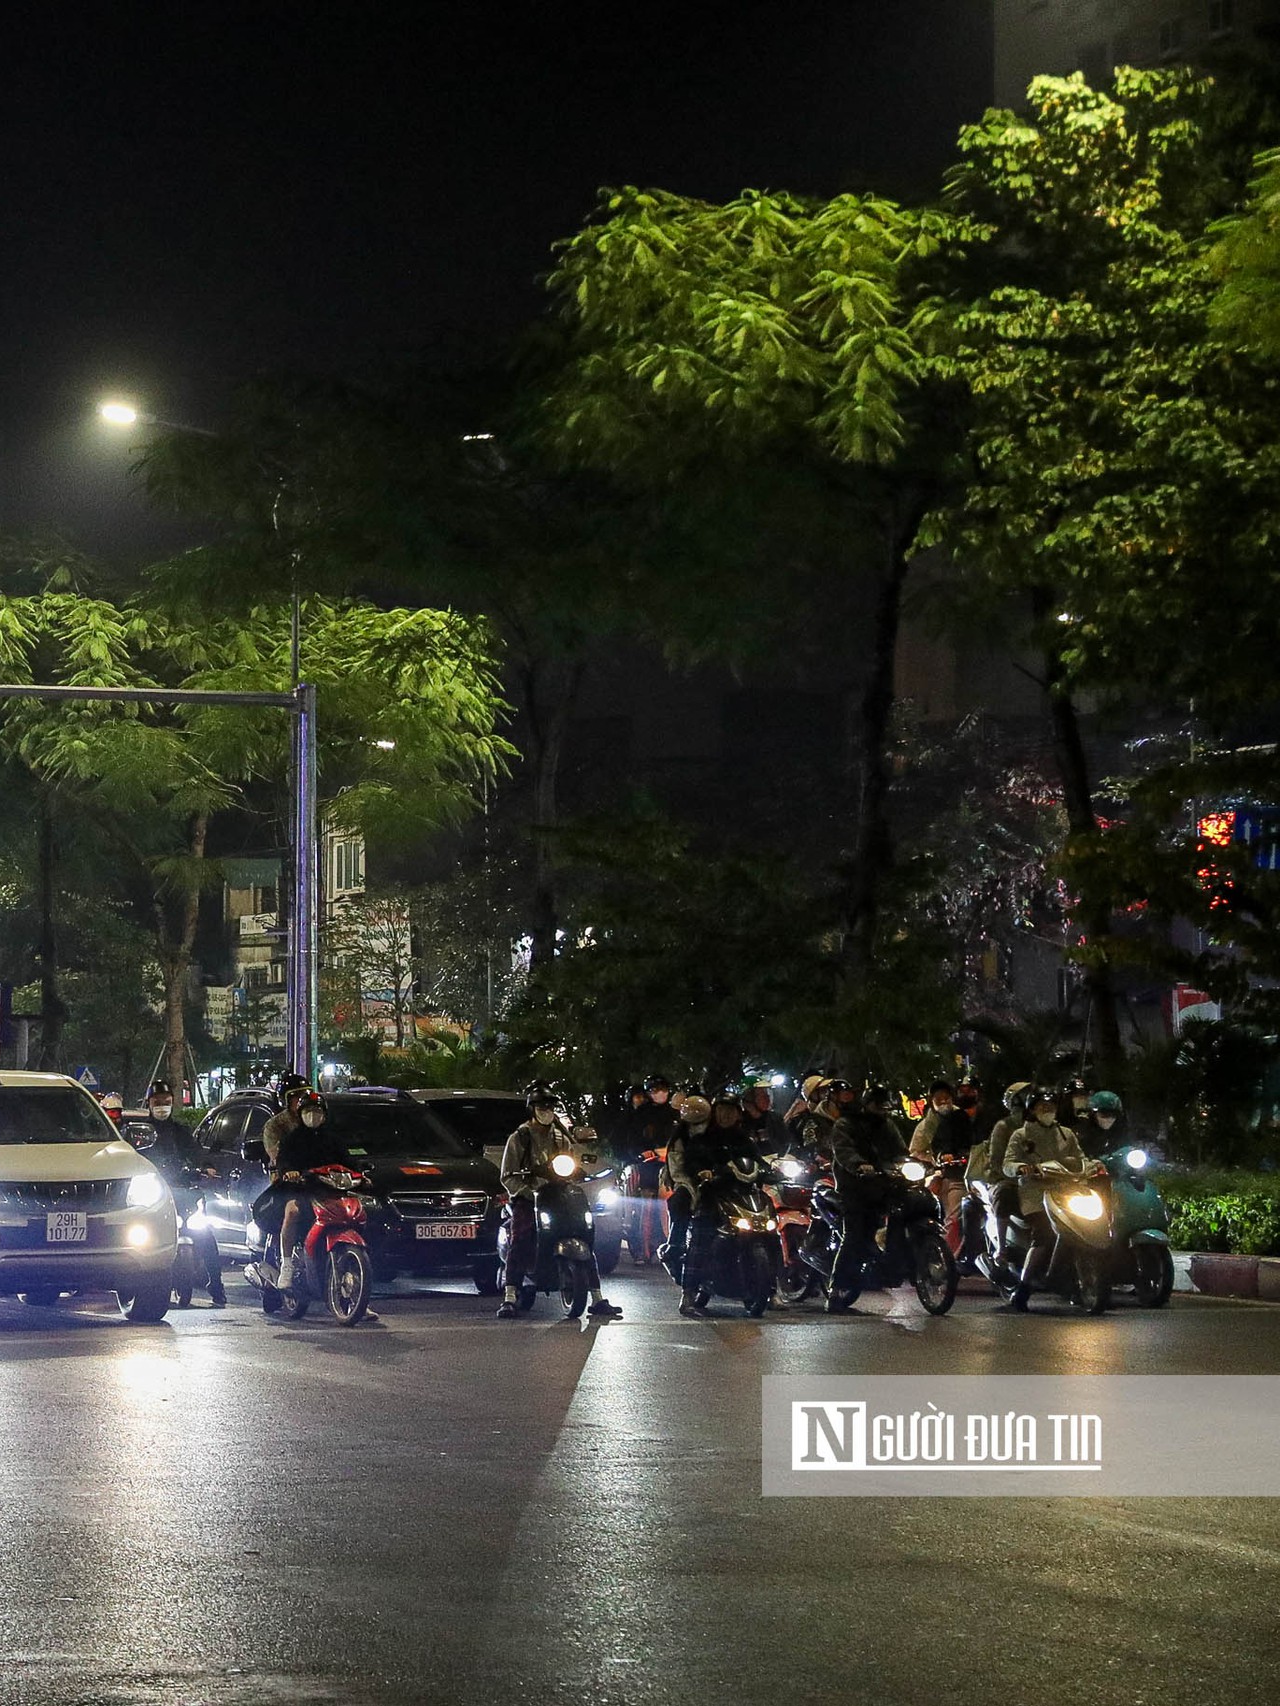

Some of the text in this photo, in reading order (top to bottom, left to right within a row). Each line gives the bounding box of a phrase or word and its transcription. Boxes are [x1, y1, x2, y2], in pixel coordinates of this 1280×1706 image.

[57, 1214, 78, 1226] 29H
[49, 1228, 85, 1240] 101.77
[417, 1225, 474, 1237] 30E-057.61
